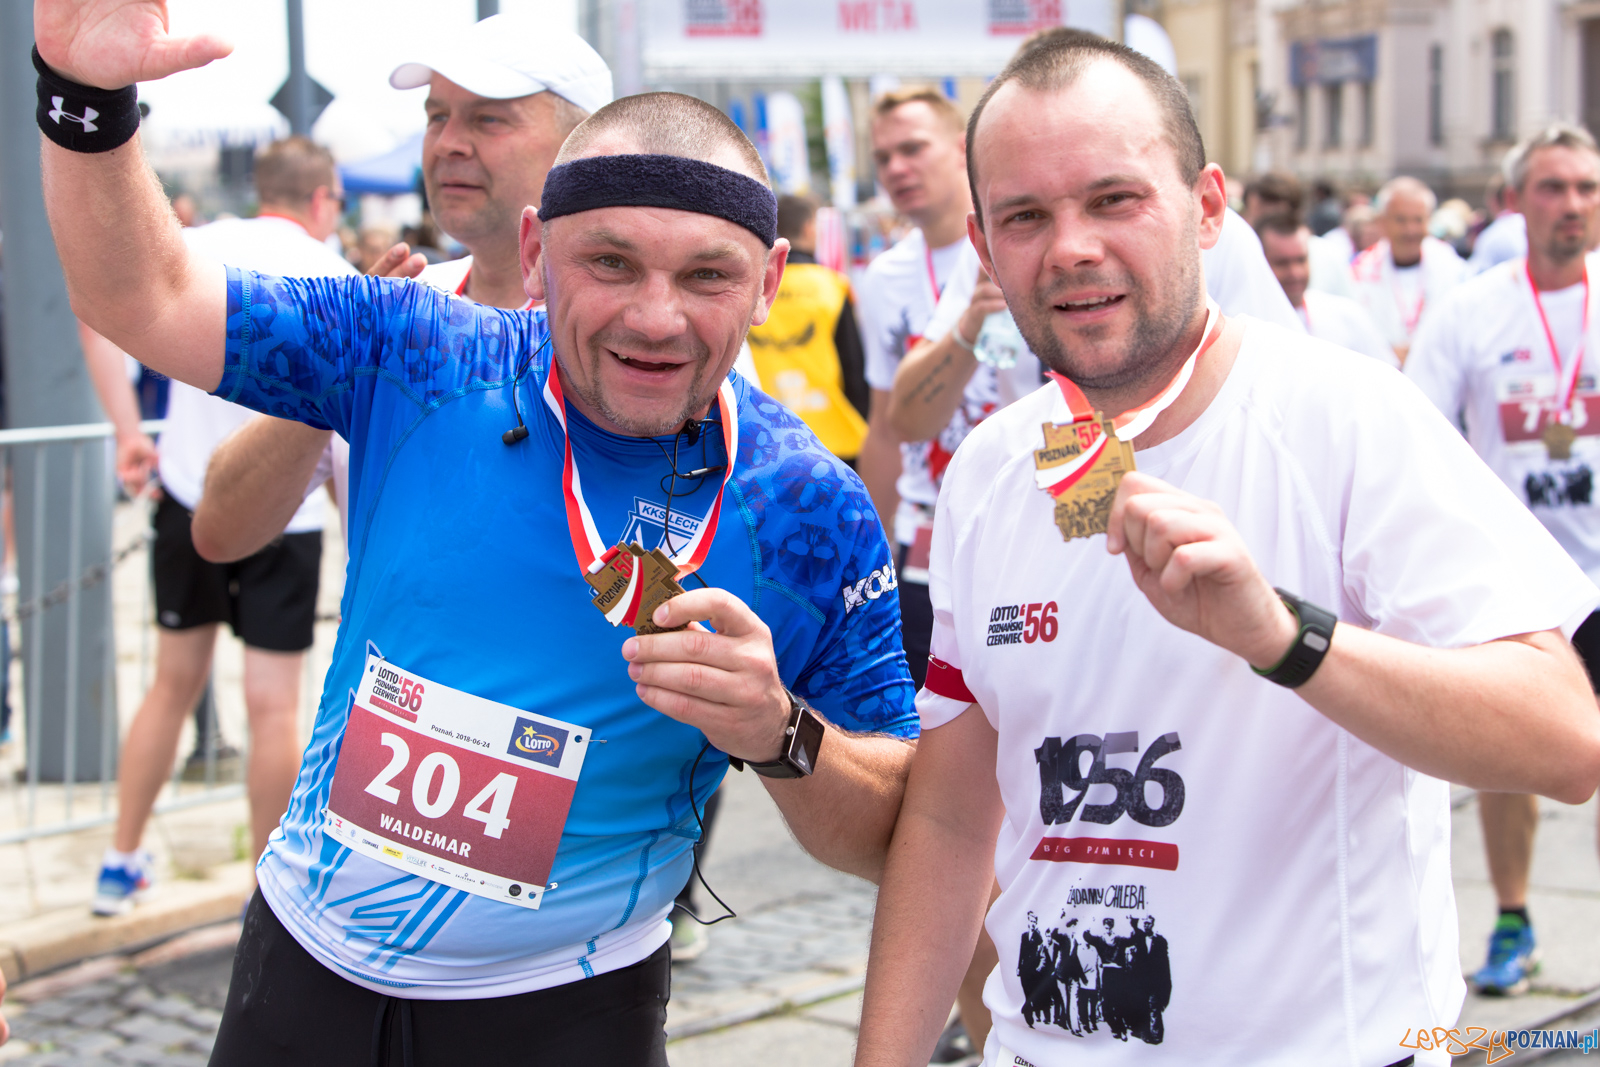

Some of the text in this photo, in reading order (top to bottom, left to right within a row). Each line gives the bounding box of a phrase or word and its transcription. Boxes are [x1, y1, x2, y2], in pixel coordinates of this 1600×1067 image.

[1038, 443, 1081, 463] POZNAŃ
[642, 504, 699, 531] KKS LECH
[597, 575, 629, 607] POZNAŃ
[990, 604, 1019, 622] LOTTO
[987, 619, 1024, 634] POZNAŃSKI
[986, 632, 1023, 647] CZERWIEC
[377, 666, 399, 685] LOTTO
[372, 685, 399, 704] CZERWIEC
[374, 677, 401, 695] POZNAŃSKI
[431, 724, 491, 749] Poznań, 2018-06-24
[524, 735, 552, 750] LOTTO
[363, 732, 519, 840] 204
[1034, 730, 1186, 828] 1956
[379, 812, 472, 858] WALDEMAR
[1104, 884, 1145, 910] CHLEBA
